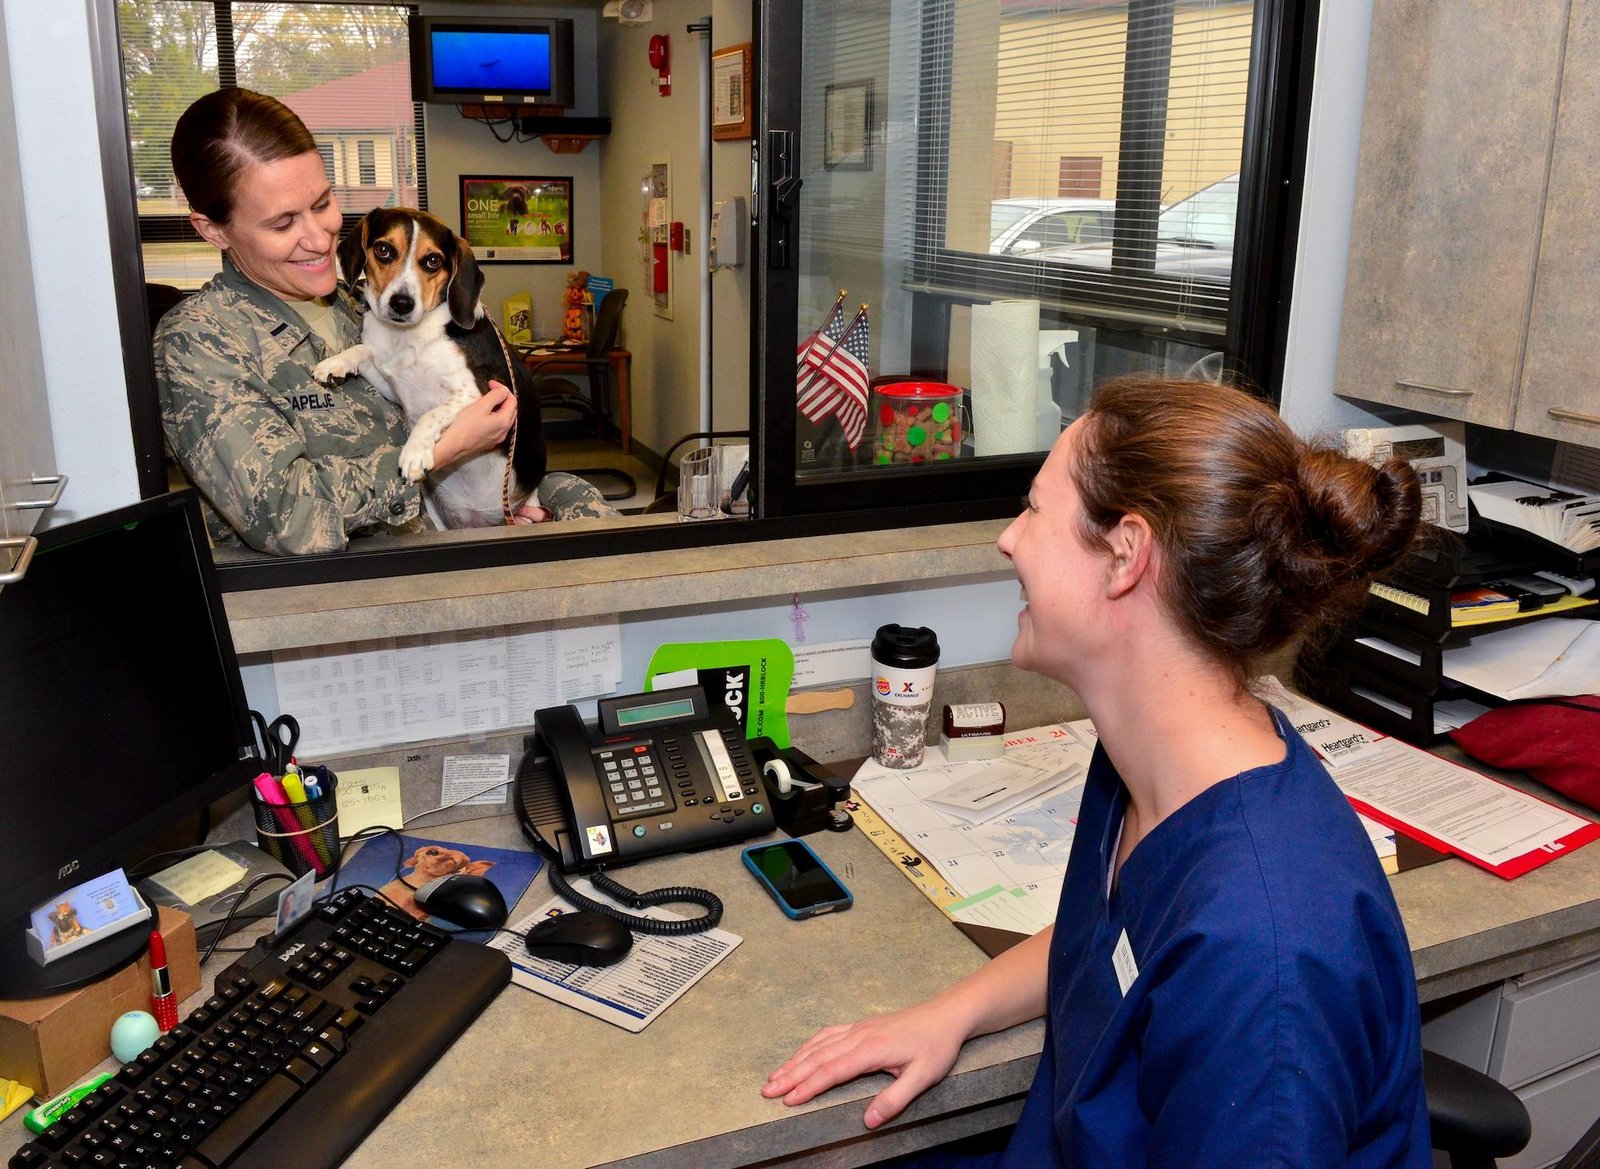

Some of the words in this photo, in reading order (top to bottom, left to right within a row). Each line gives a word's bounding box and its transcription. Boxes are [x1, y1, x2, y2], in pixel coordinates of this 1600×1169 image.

[468, 199, 499, 212] ONE
[285, 393, 335, 411] APELJE
[725, 672, 744, 725] OCK
[957, 704, 999, 719] ACTIVE
[1296, 719, 1326, 733] artgard
[1004, 736, 1038, 747] BER
[278, 943, 305, 961] DELL
